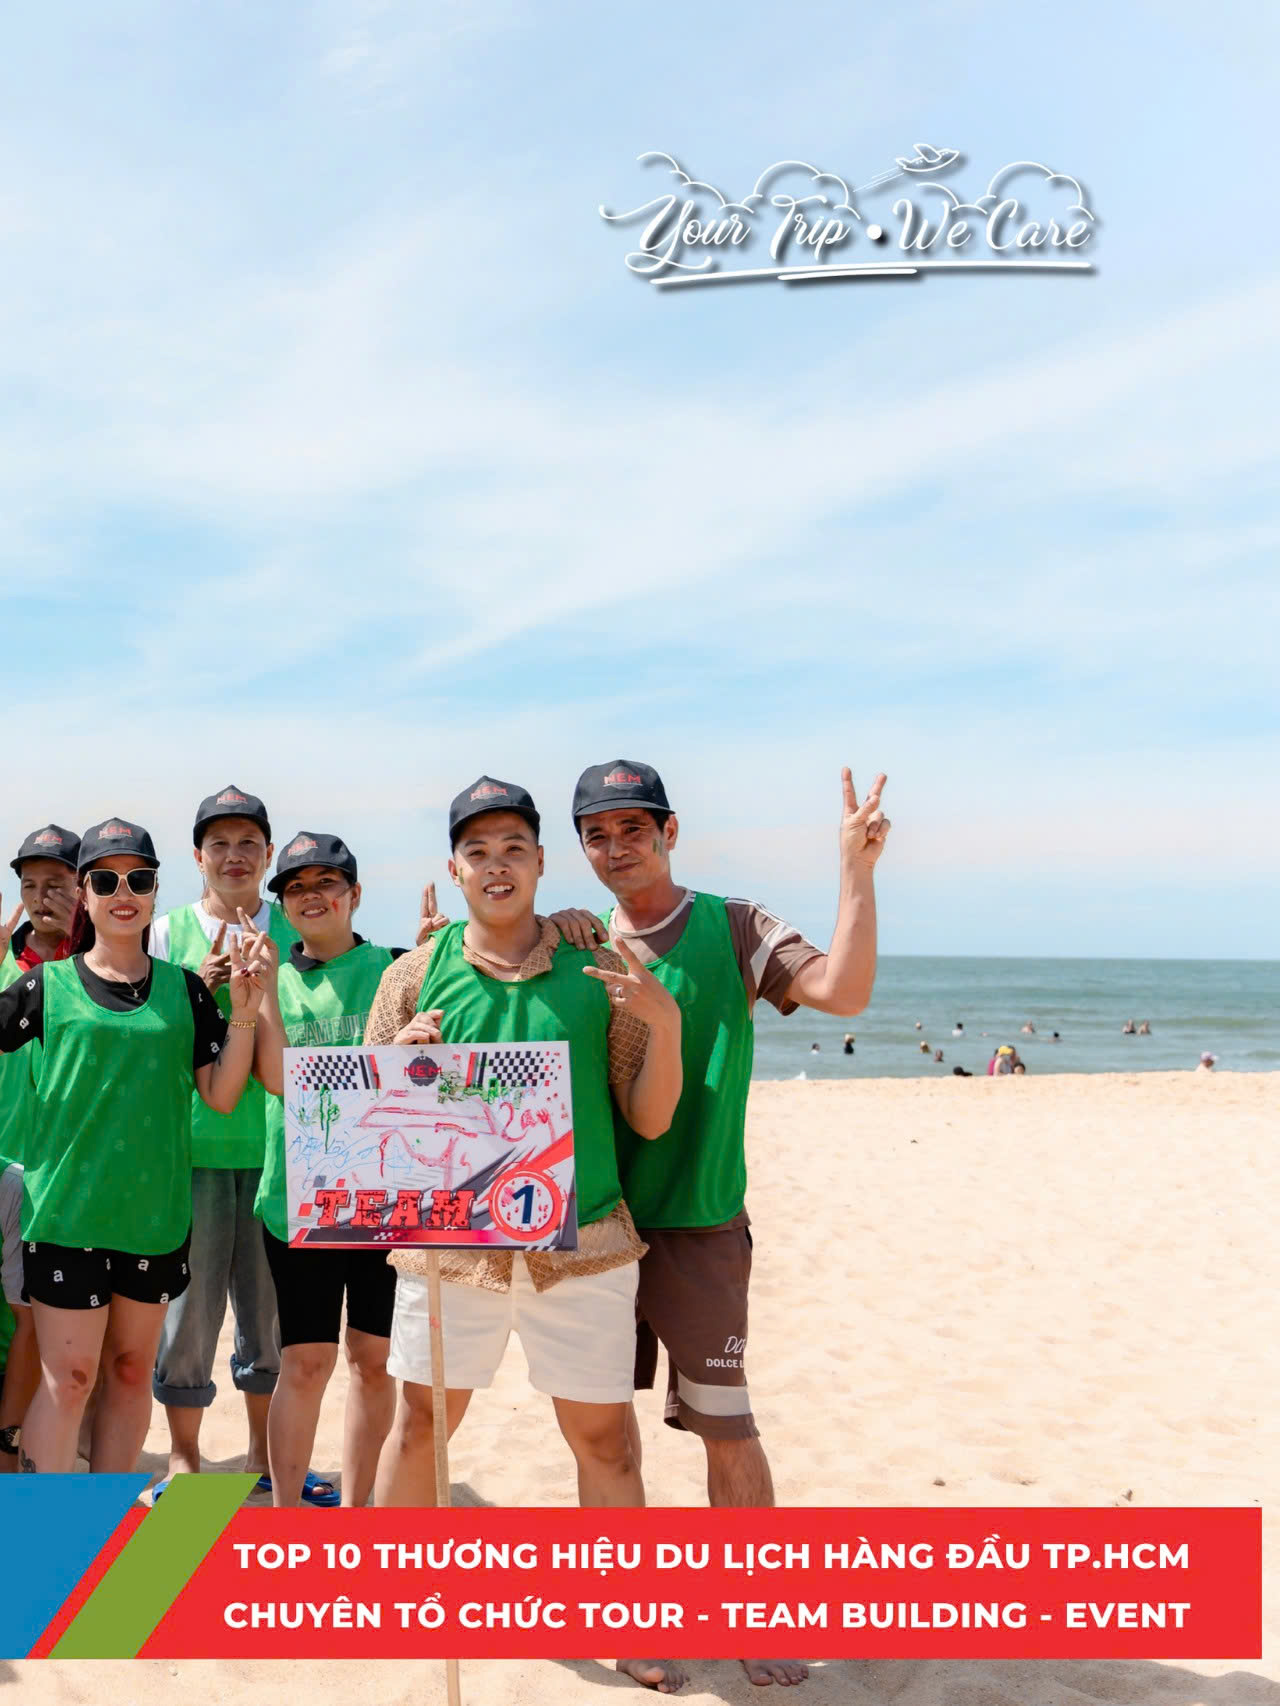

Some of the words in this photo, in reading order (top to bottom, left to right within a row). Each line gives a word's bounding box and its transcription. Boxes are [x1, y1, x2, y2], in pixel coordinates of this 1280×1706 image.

[604, 772, 641, 785] NEM
[471, 786, 508, 799] NEM
[404, 1065, 442, 1077] NEM
[314, 1189, 476, 1229] TEAM
[512, 1184, 535, 1225] 1
[706, 1358, 738, 1368] DOLCE
